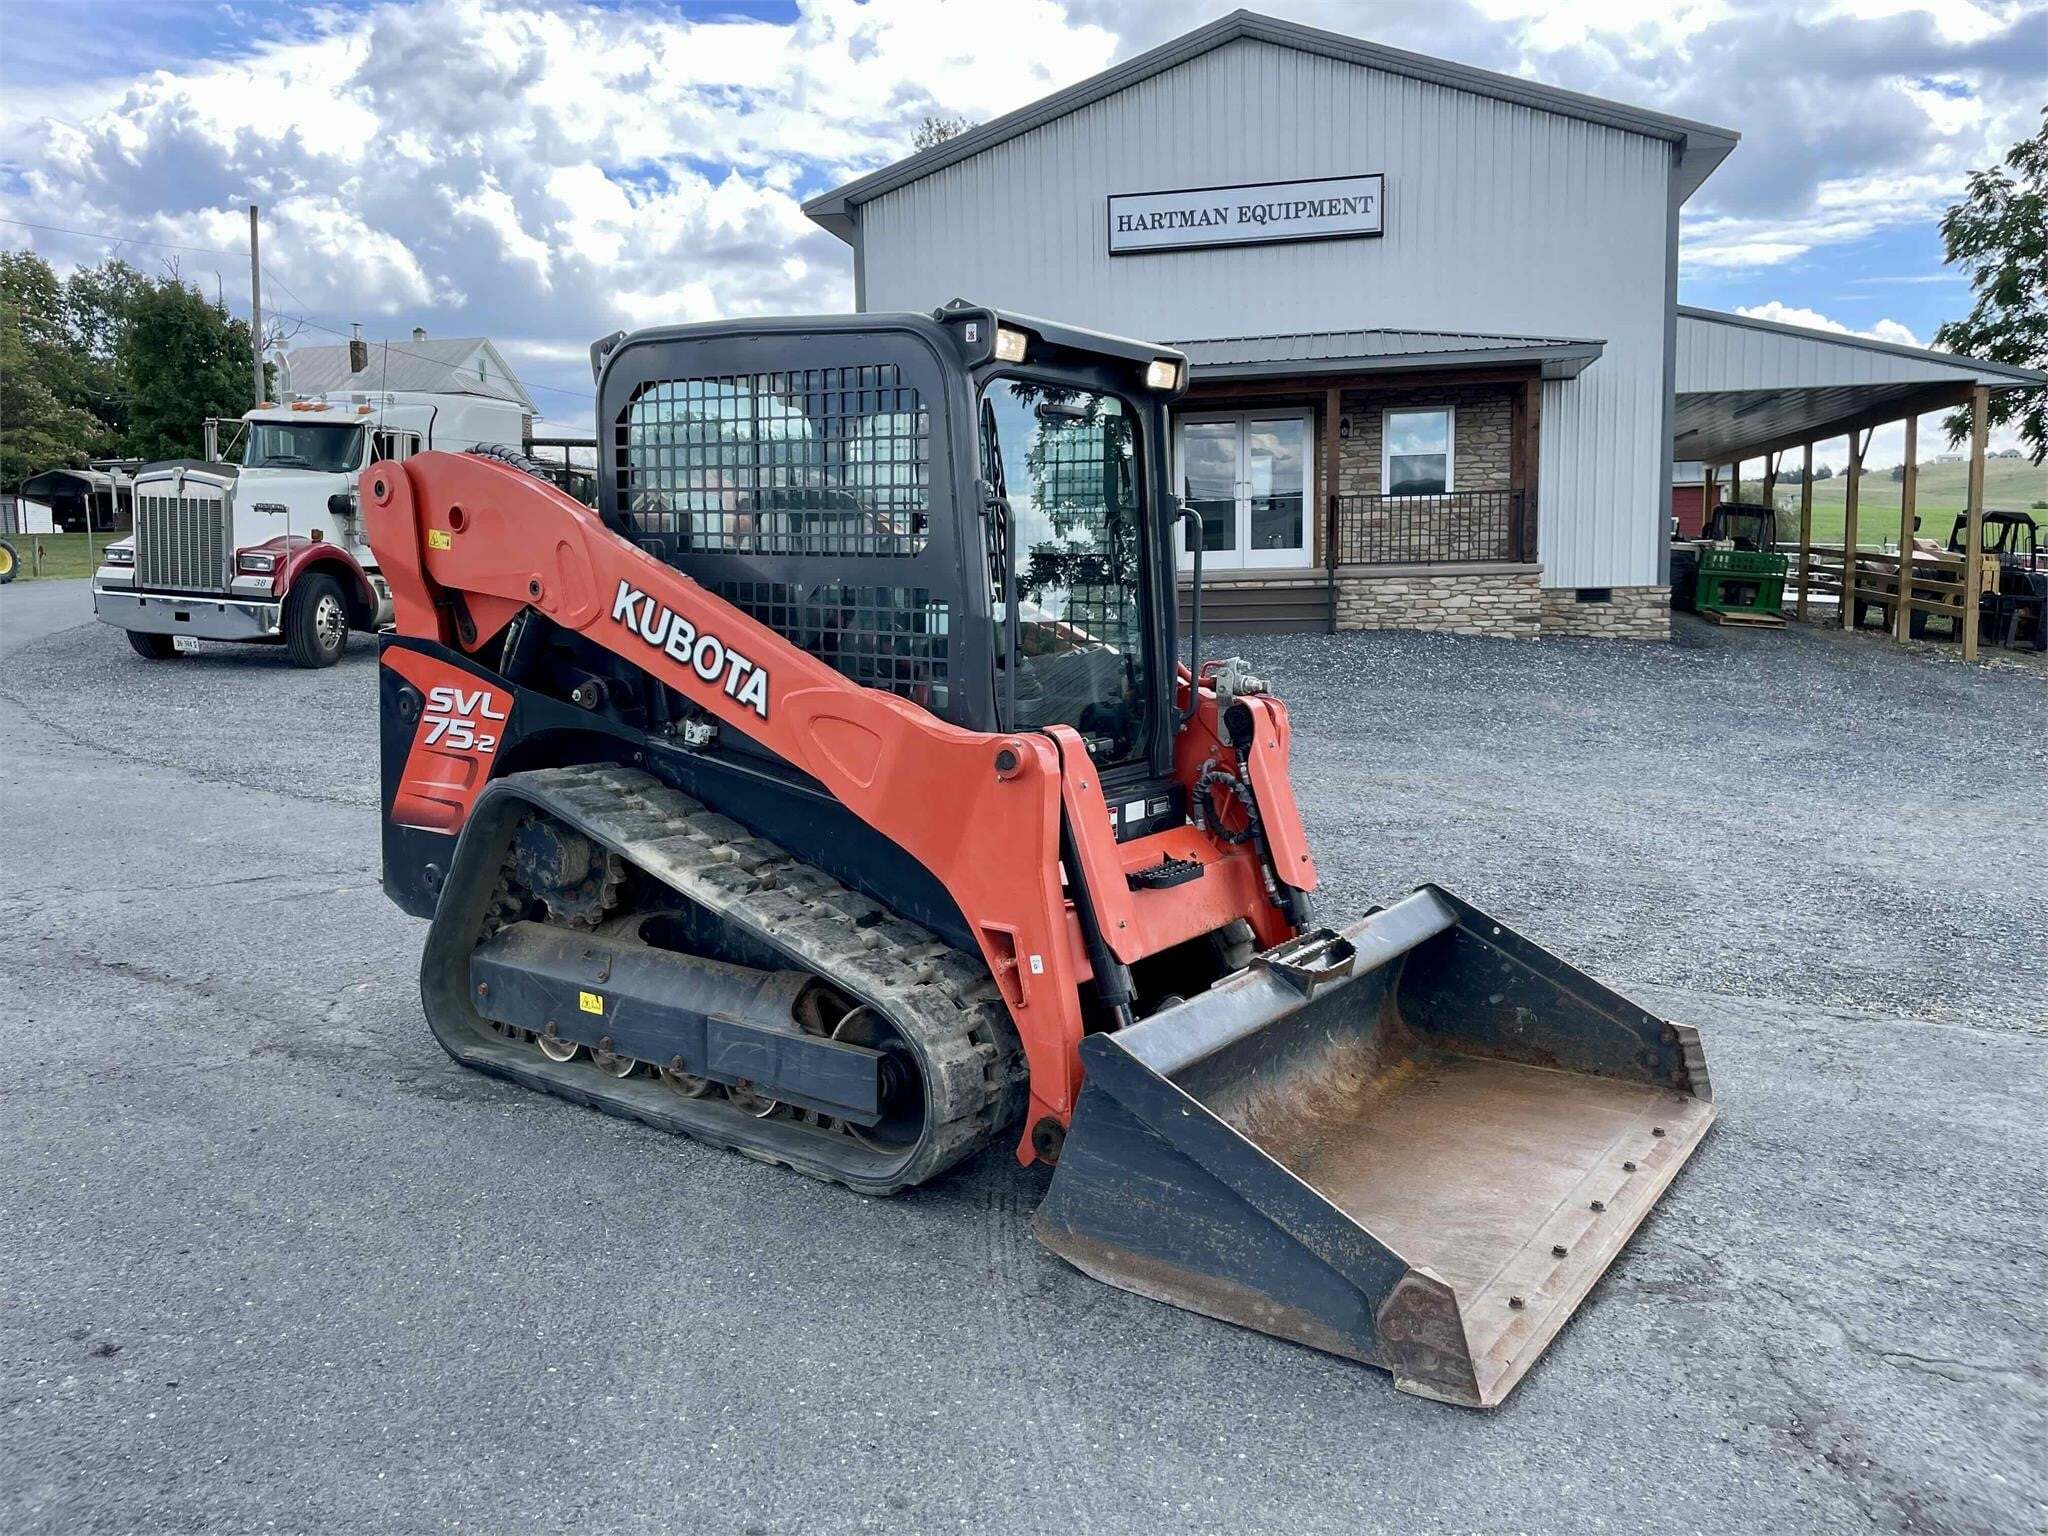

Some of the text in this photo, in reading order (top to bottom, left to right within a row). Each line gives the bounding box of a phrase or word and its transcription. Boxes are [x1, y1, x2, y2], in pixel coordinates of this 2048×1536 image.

[1117, 195, 1374, 233] HARTMAN EQUIPMENT
[611, 580, 770, 717] KUBOTA
[427, 686, 505, 720] SVL
[423, 715, 496, 753] 75-2
